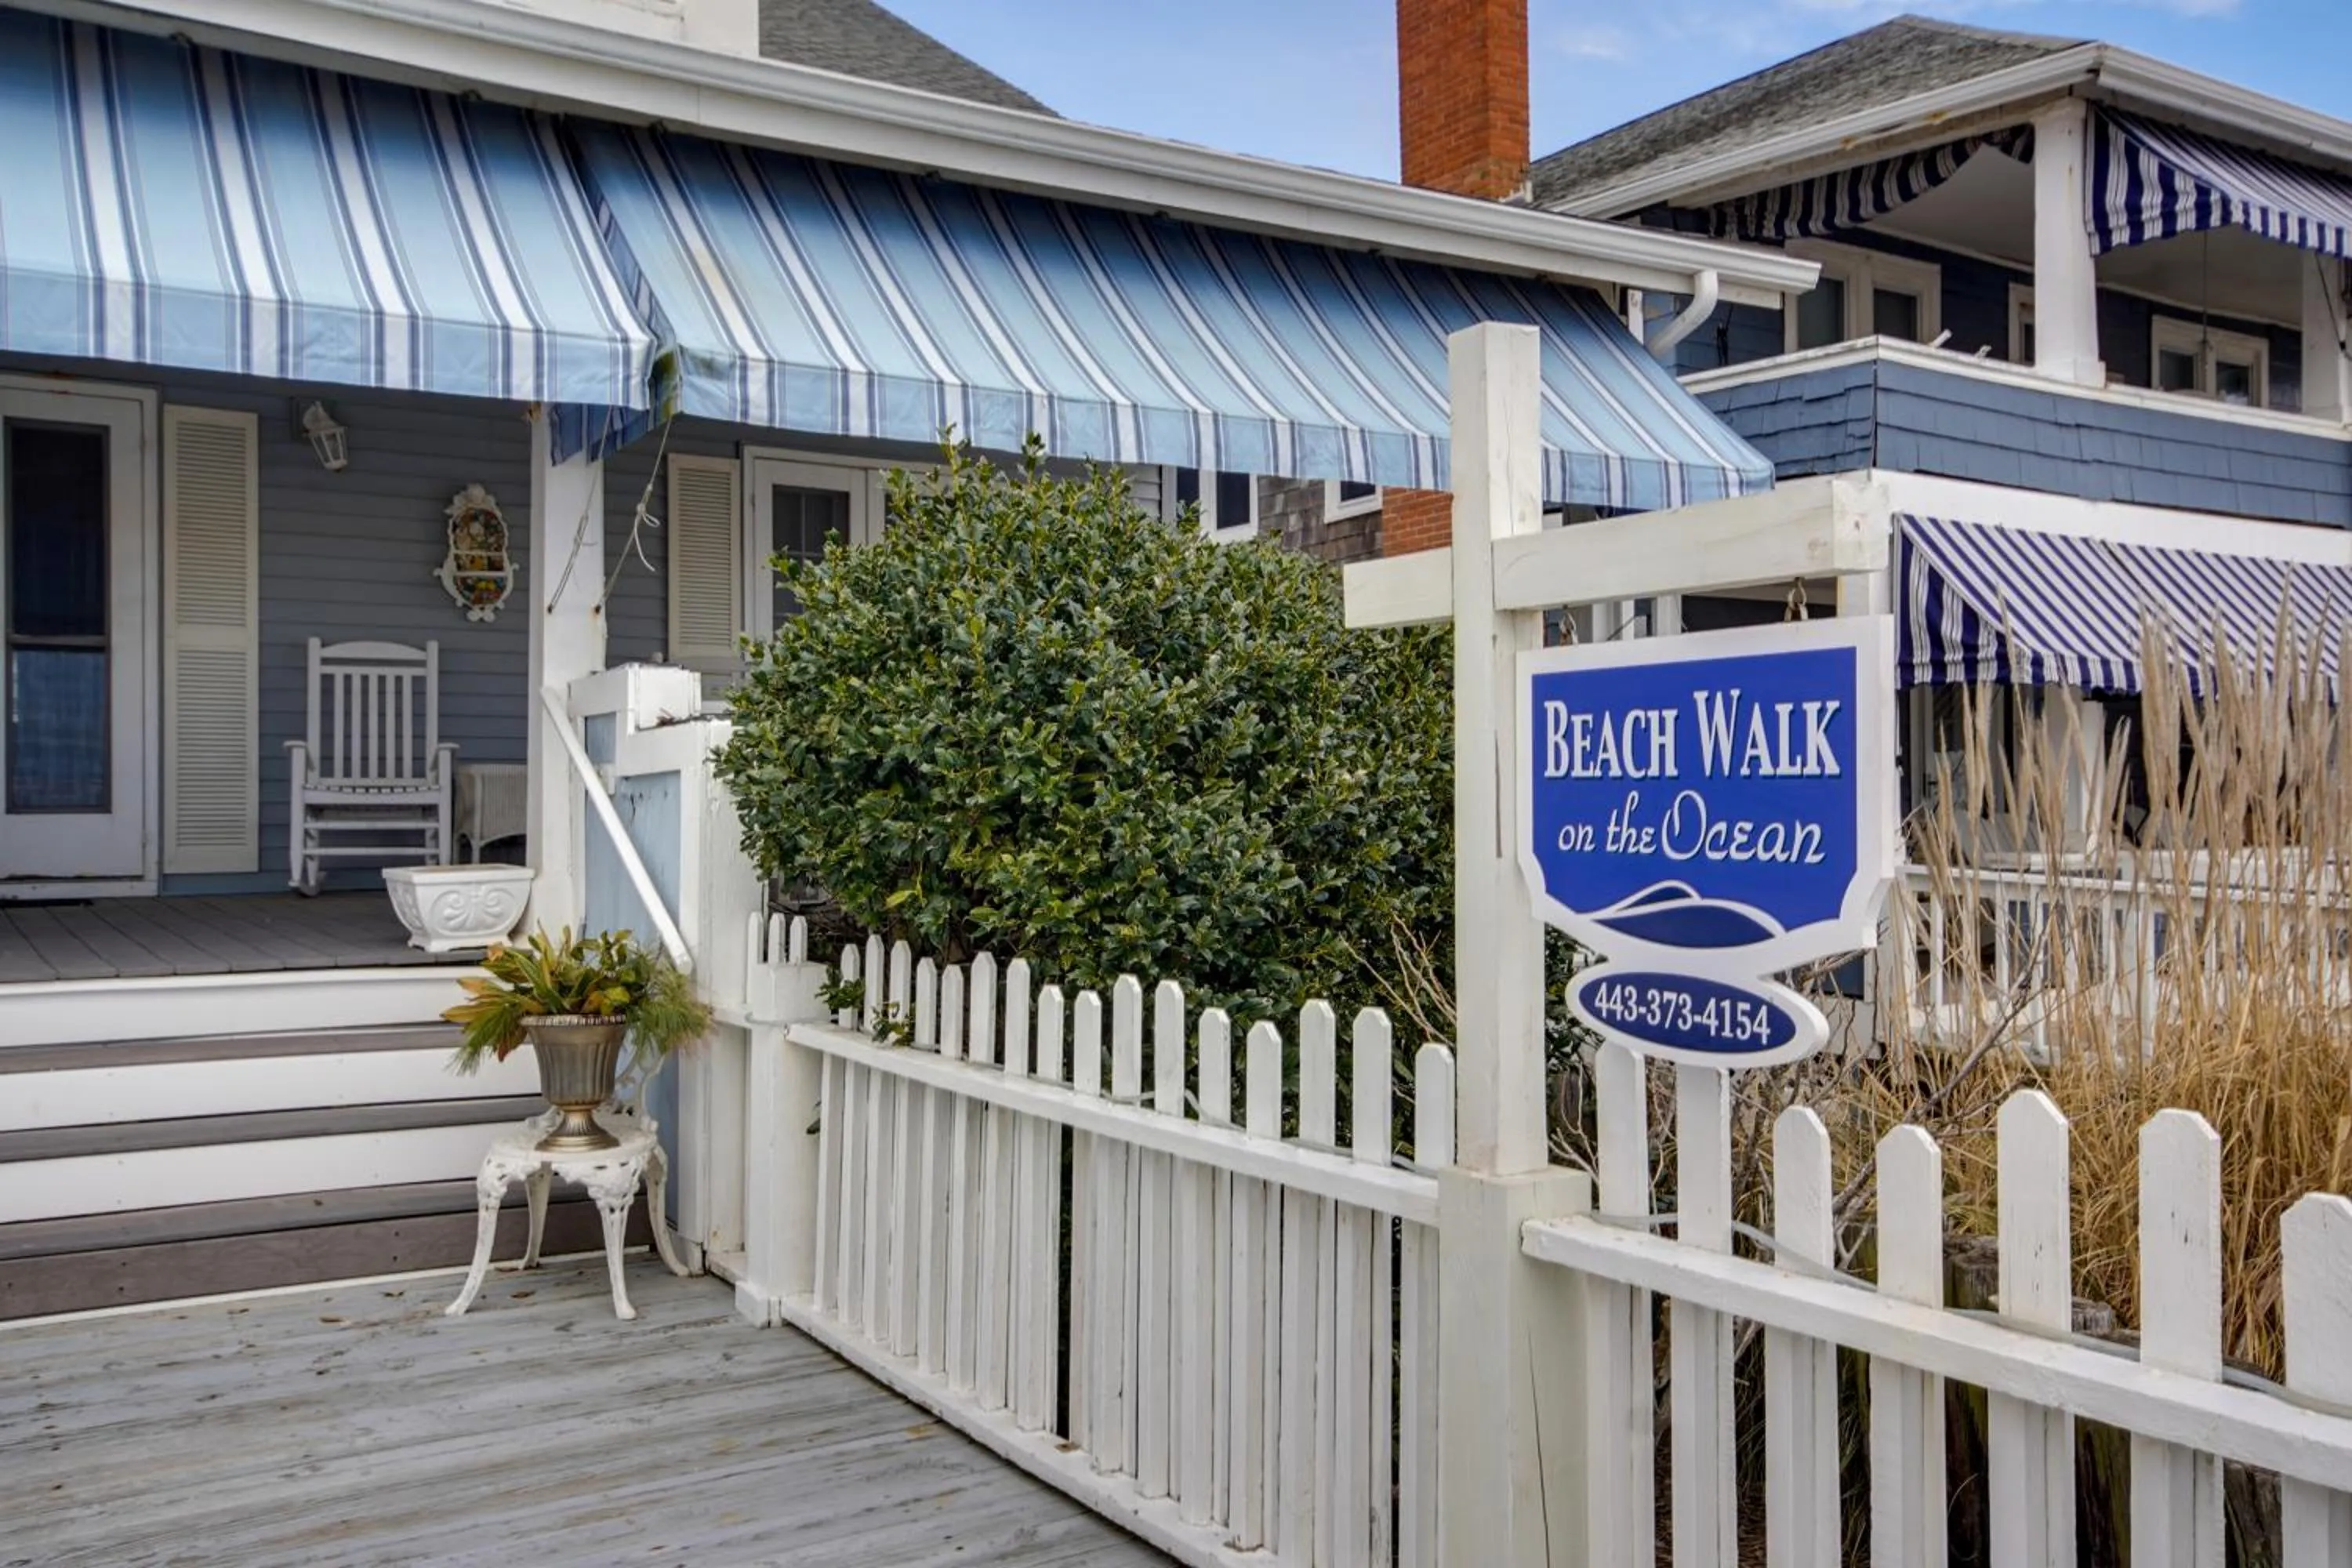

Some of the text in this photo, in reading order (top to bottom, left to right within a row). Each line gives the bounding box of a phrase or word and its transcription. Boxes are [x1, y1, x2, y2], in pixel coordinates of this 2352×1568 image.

[1544, 688, 1840, 779] BEACH WALK
[1558, 789, 1826, 863] on the Ocean
[1594, 981, 1771, 1044] 443-373-4154
